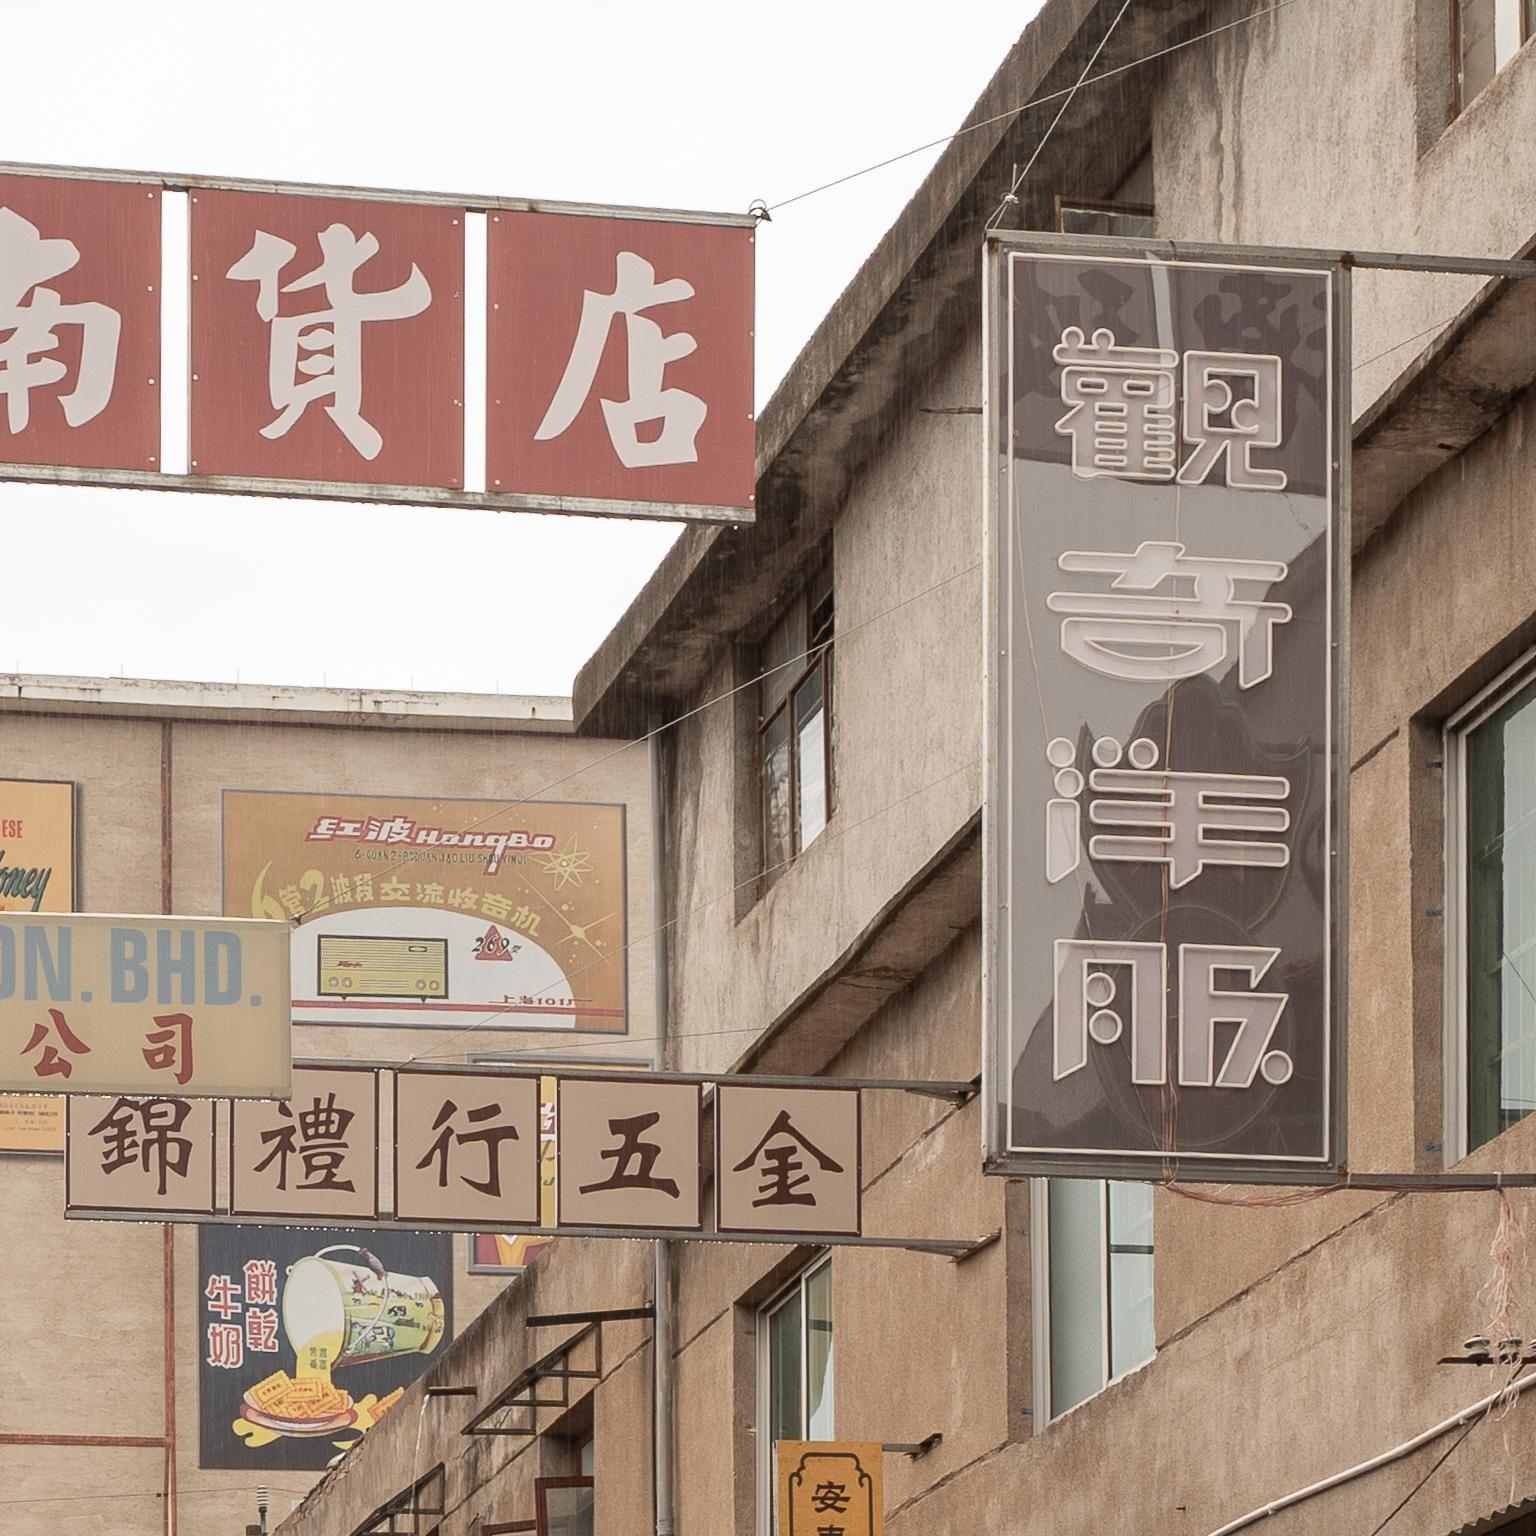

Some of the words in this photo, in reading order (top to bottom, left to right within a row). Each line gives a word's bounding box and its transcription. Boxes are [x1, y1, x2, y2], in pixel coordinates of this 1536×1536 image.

[1045, 327, 1294, 1089] 觀奇洋服
[109, 926, 263, 1008] BHD.
[89, 1097, 844, 1209] 錦禮行五金
[206, 1275, 243, 1369] 牛奶
